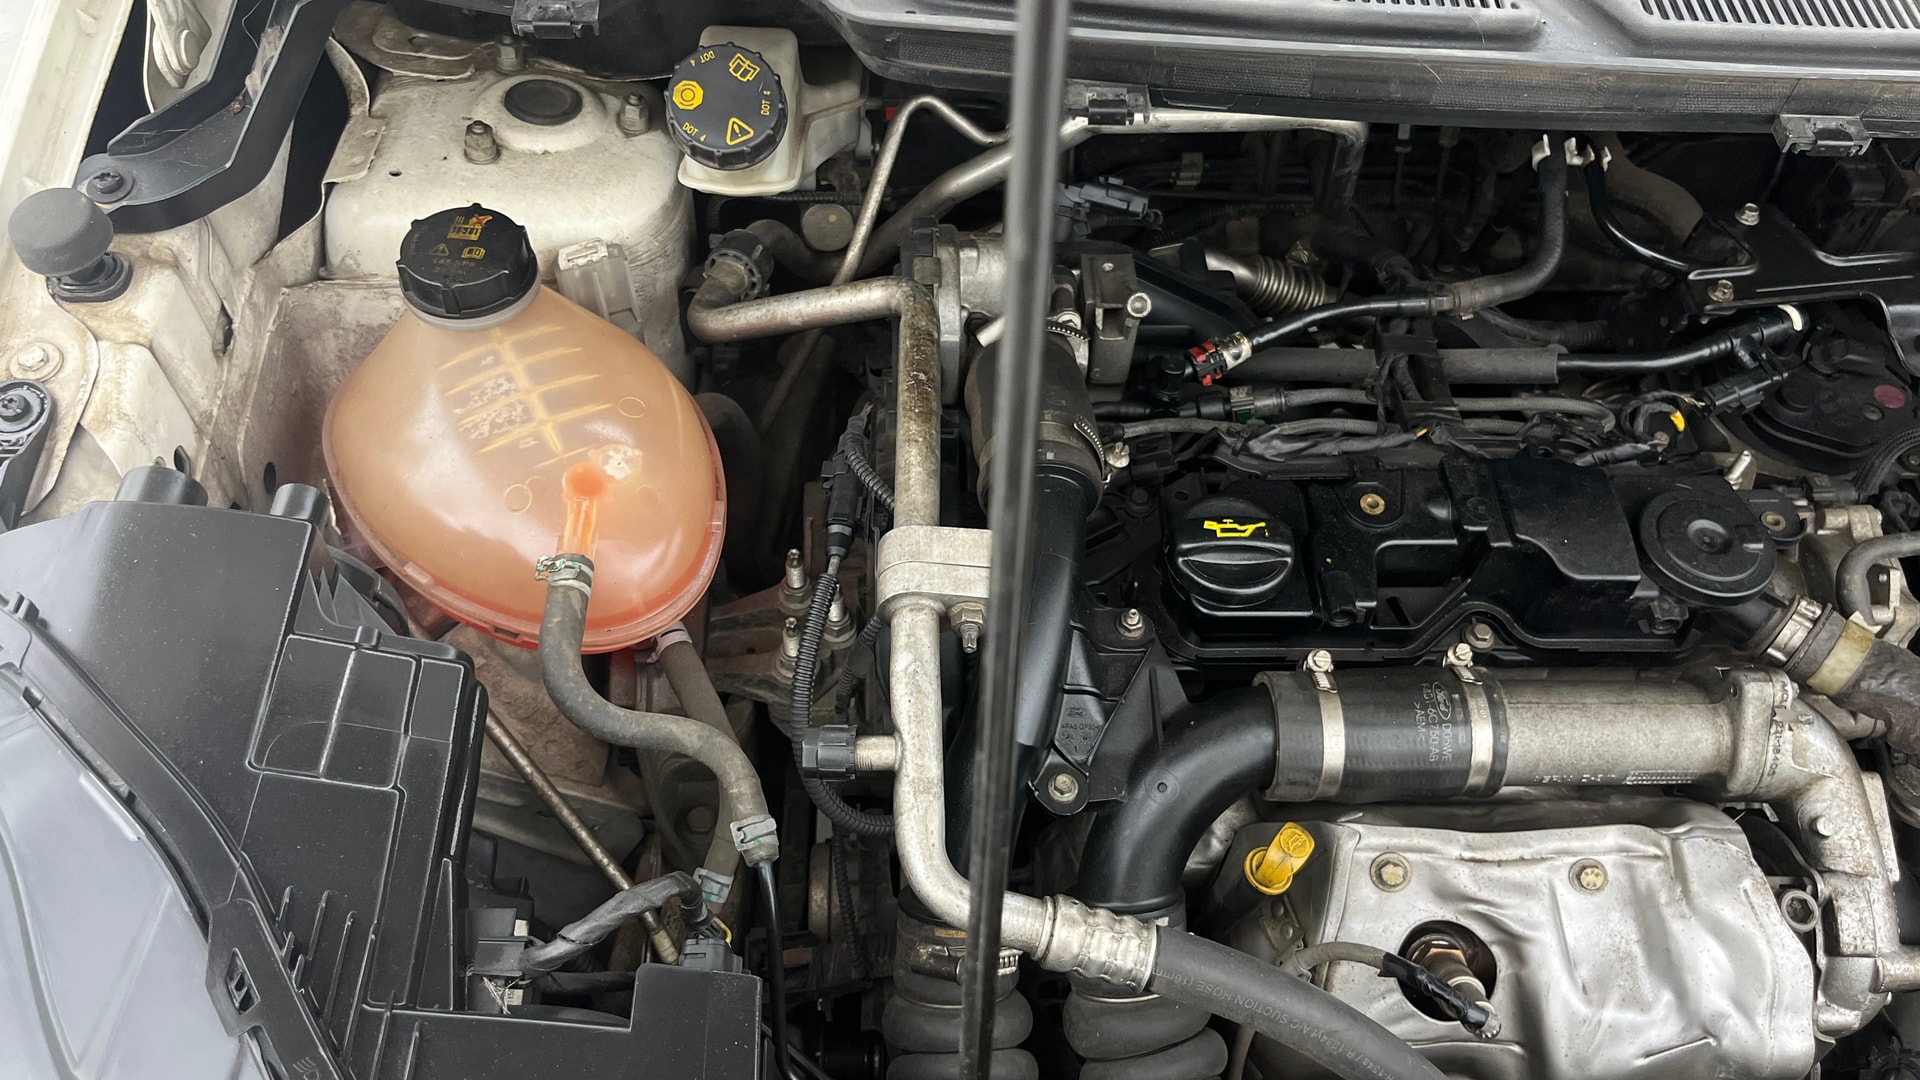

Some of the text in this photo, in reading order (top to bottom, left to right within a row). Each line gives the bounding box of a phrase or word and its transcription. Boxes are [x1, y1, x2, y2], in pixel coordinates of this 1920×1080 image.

[690, 51, 715, 67] DOT 4
[761, 99, 770, 115] DOT
[683, 122, 706, 142] DOT 4
[1196, 979, 1232, 1002] HOSE
[1233, 994, 1289, 1024] SUCTION
[1289, 1018, 1312, 1035] A/C
